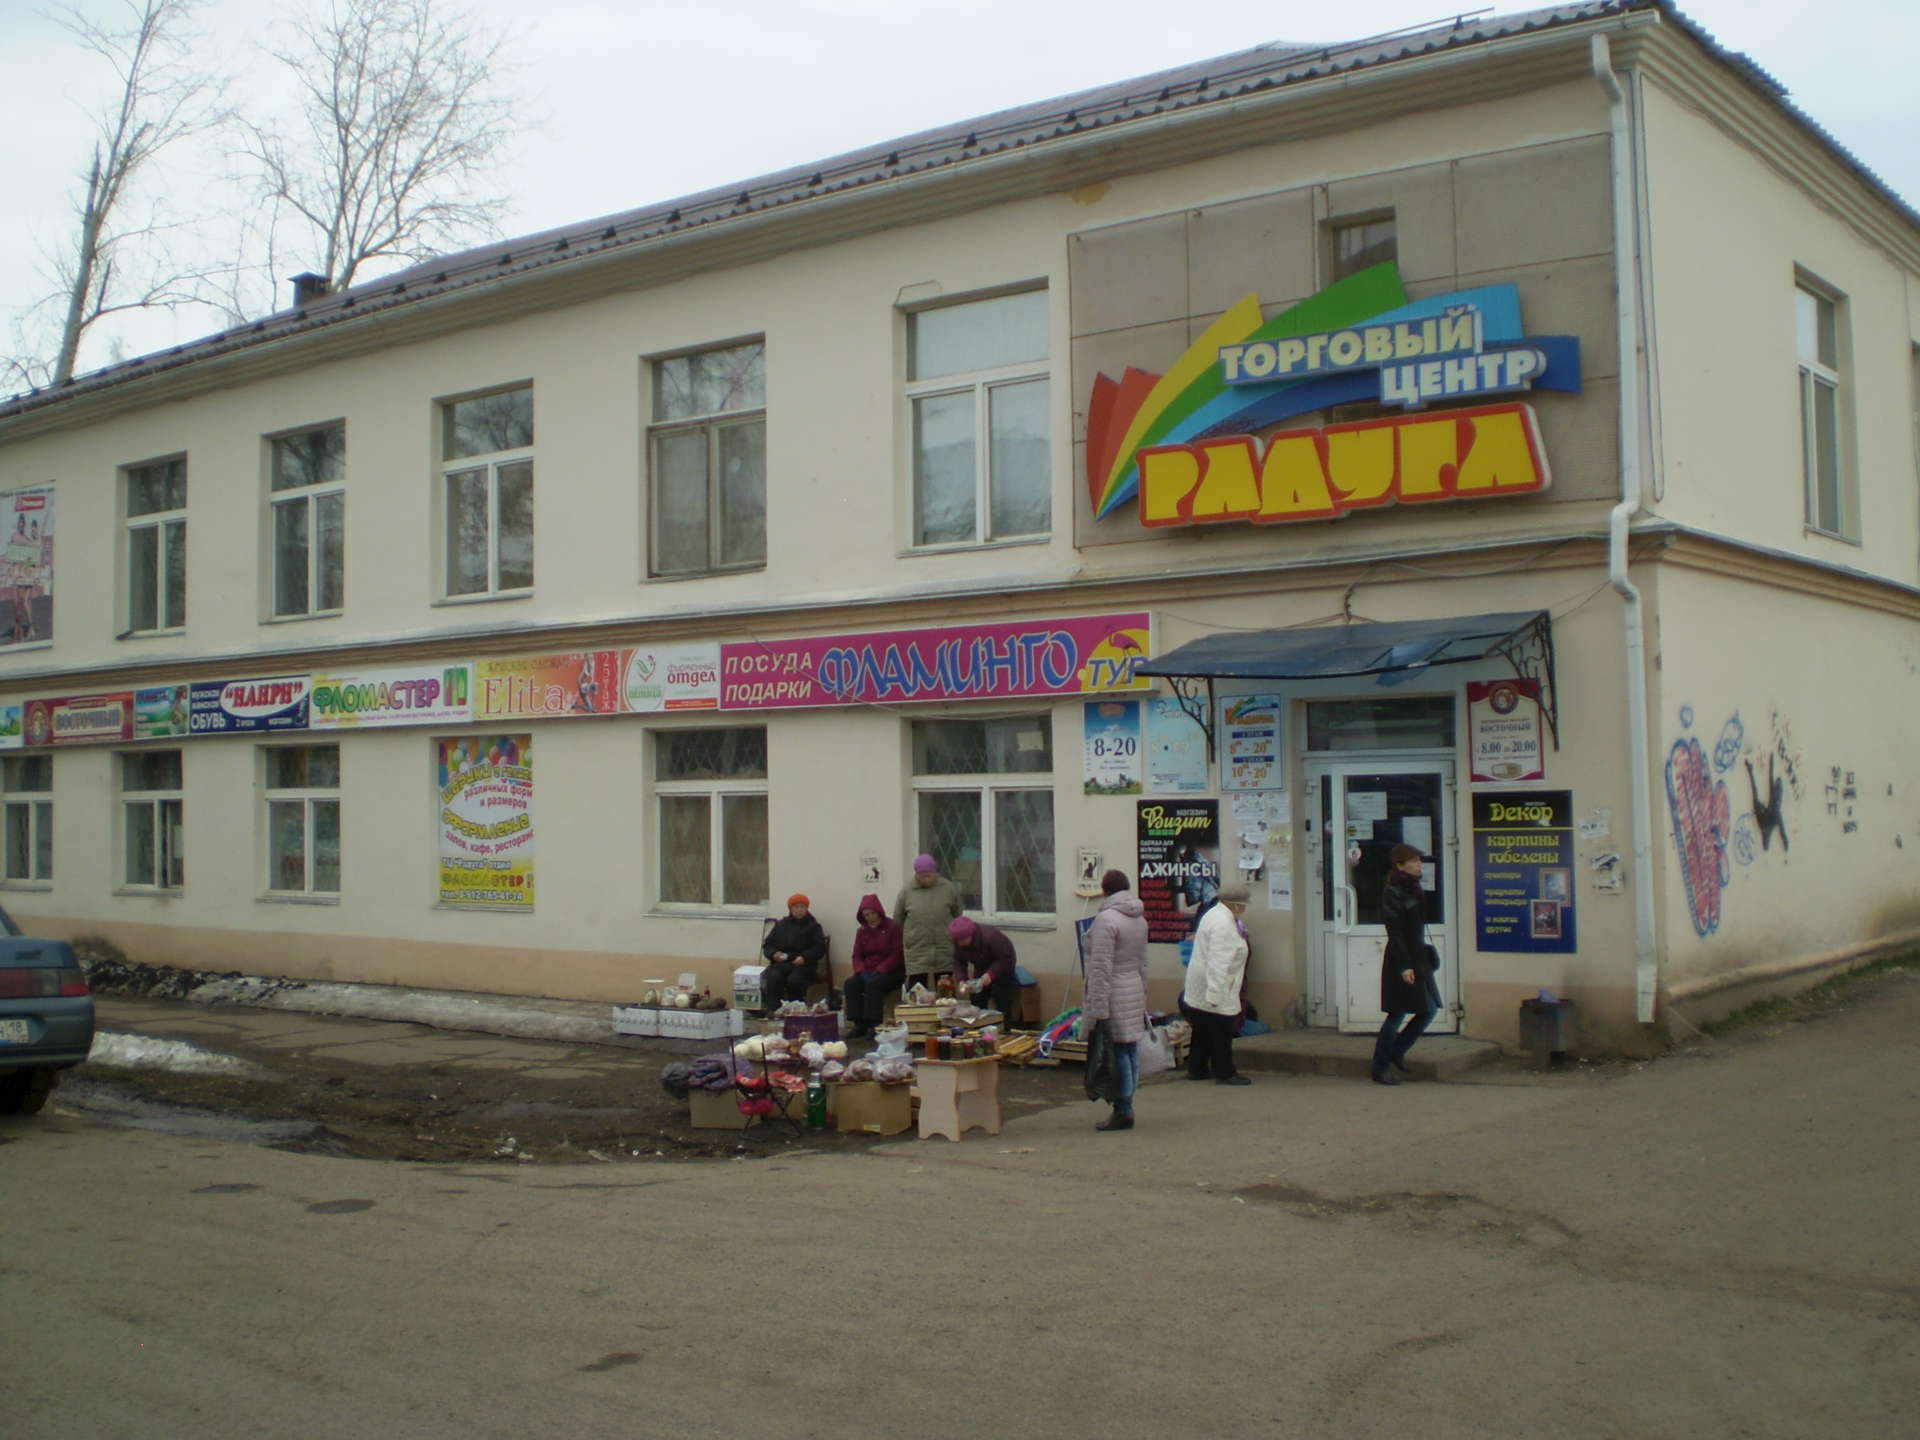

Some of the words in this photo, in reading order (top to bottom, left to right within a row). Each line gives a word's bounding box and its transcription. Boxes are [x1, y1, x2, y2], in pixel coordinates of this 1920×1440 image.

[1220, 305, 1476, 381] ТОРГОВЫЙ
[1382, 350, 1538, 407] ЦЕНТР
[1144, 411, 1538, 521] РАДУГА
[725, 652, 813, 674] ПОСУДА
[817, 630, 1078, 700] ФЛАМИНГО
[312, 679, 441, 714] ФЛОМАСТЕР
[482, 675, 566, 715] Elita
[725, 681, 812, 704] ПОДАРКИ
[191, 713, 226, 730] ОБУВЬ
[1094, 736, 1136, 757] 8-20
[1142, 805, 1213, 836] Визит
[1487, 834, 1560, 850] картины
[1140, 862, 1216, 878] ДЖИНСЫ
[1488, 850, 1559, 865] гобелены
